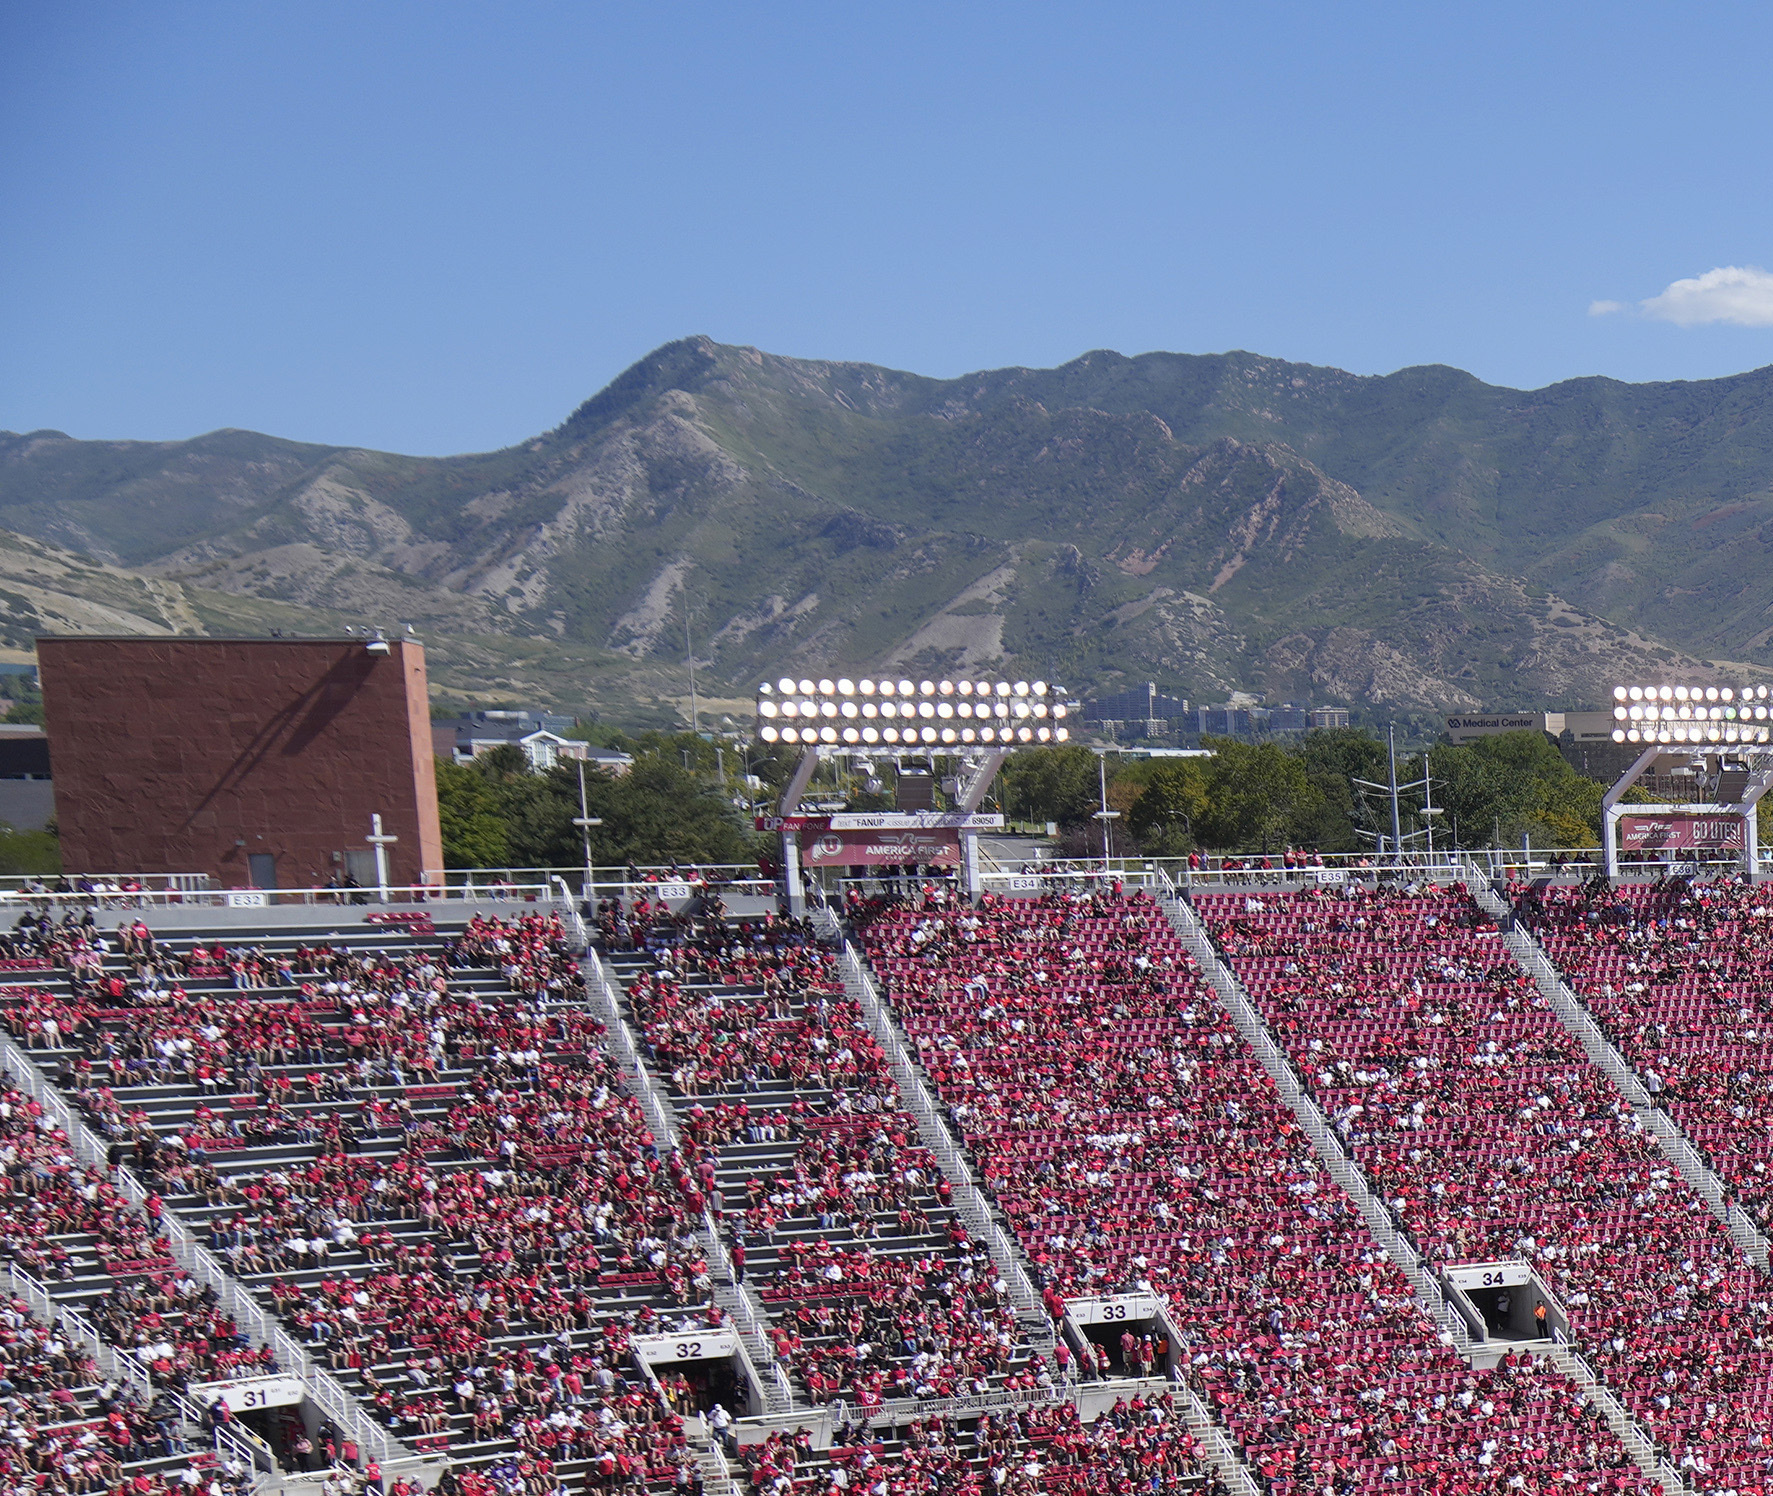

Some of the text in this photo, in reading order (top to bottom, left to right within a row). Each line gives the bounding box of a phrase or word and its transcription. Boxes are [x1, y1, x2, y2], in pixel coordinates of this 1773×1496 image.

[1463, 717, 1533, 728] Medical Center
[783, 822, 824, 831] FAN FONE
[1692, 822, 1742, 839] GO UTES!
[1626, 830, 1682, 841] AMERICA FIRST
[865, 845, 950, 856] AMERICA FIRST
[1672, 865, 1691, 875] E36
[1013, 880, 1035, 890] E34
[662, 887, 687, 897] E33
[233, 895, 260, 906] E32
[1483, 1271, 1504, 1286] 34
[1103, 1305, 1127, 1321] 33
[676, 1342, 702, 1359] 32
[244, 1389, 267, 1407] 31
